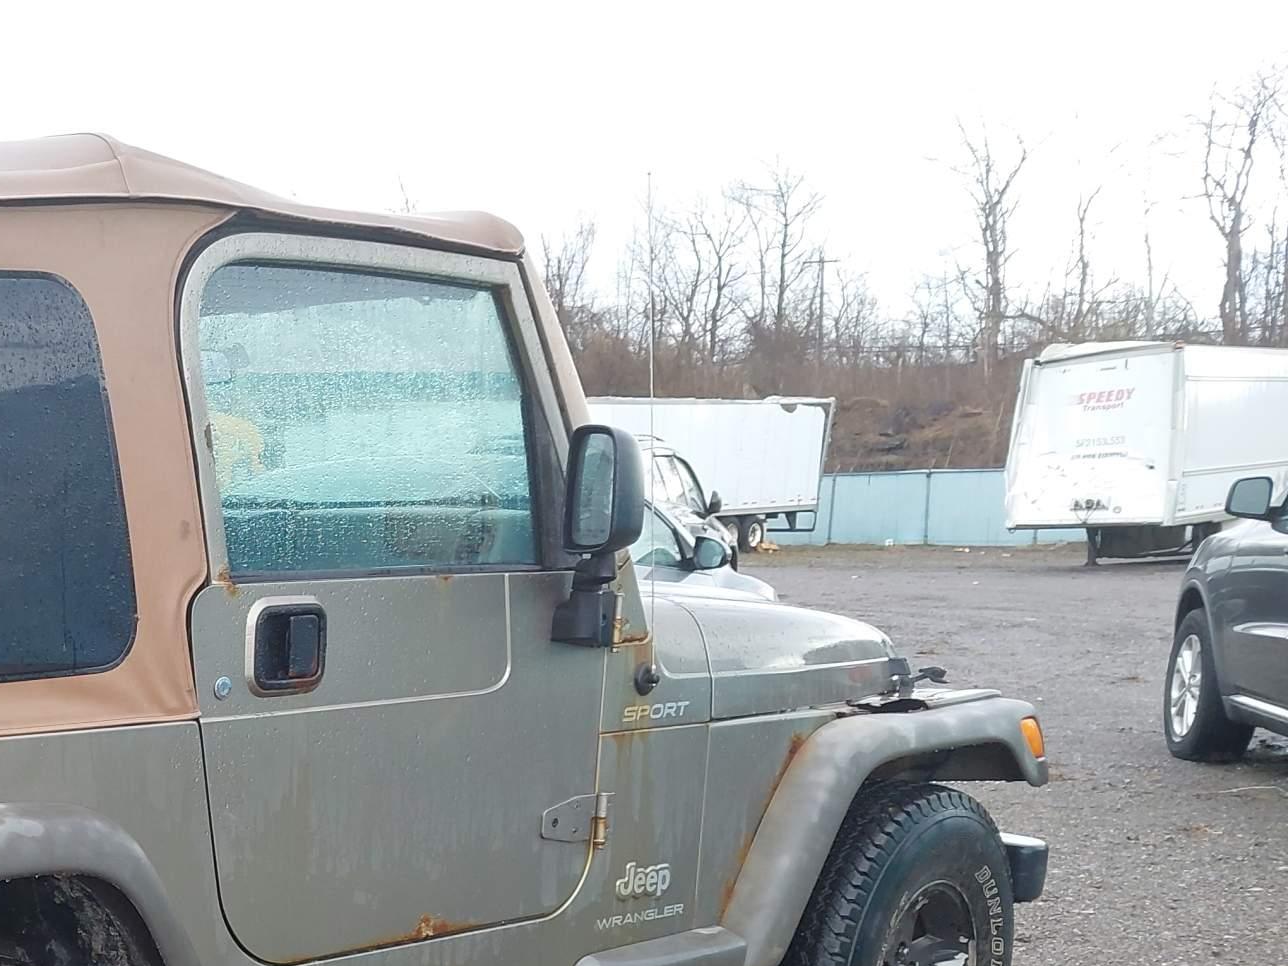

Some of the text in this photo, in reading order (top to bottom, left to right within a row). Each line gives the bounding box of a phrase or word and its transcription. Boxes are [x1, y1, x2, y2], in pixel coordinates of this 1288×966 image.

[1077, 386, 1136, 405] SPEEDY
[1082, 402, 1125, 412] Transport
[622, 701, 690, 722] SPORT
[616, 862, 671, 898] Jeep
[596, 903, 685, 930] WRANGLER
